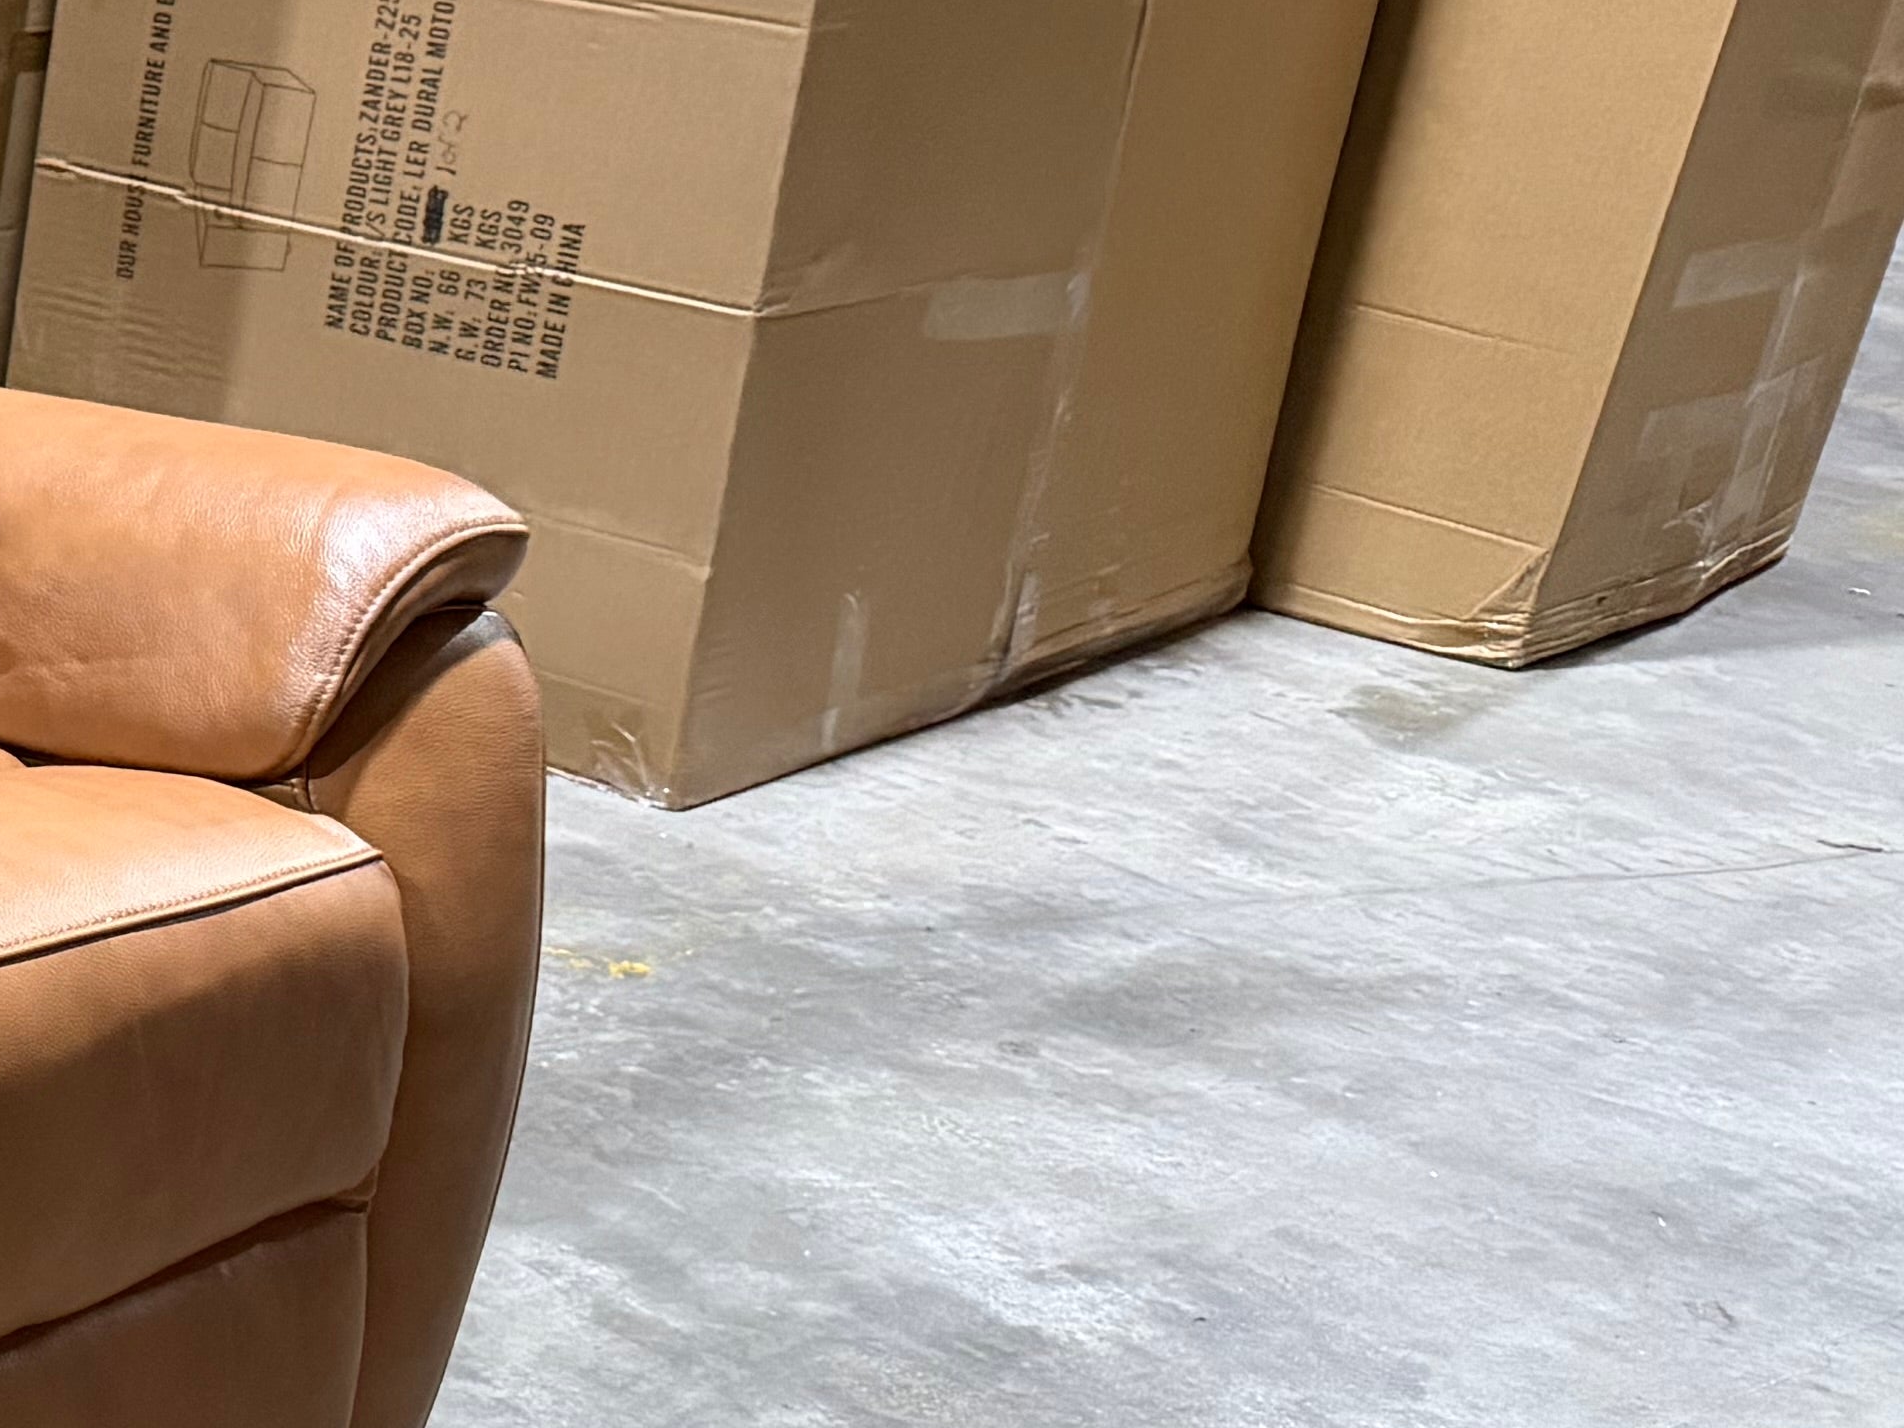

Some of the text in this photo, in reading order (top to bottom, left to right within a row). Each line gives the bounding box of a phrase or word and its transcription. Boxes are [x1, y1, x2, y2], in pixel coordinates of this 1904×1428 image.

[369, 14, 422, 207] LIGHT GREY L18-25
[412, 67, 443, 132] DURAL
[116, 239, 137, 280] OUR
[132, 58, 165, 167] FURNITURE
[149, 12, 172, 53] AND
[404, 140, 431, 178] LER
[448, 204, 474, 244] KGS
[475, 209, 502, 250] KGS
[324, 272, 352, 330] NAME
[375, 247, 409, 342] PRODUCT
[410, 269, 435, 304] NO:
[437, 270, 461, 296] 66
[464, 278, 487, 301] 73
[535, 223, 586, 379] MADE IN CHINA
[402, 308, 426, 349] BOX
[480, 299, 512, 368] ORDER
[507, 351, 531, 374] PI
